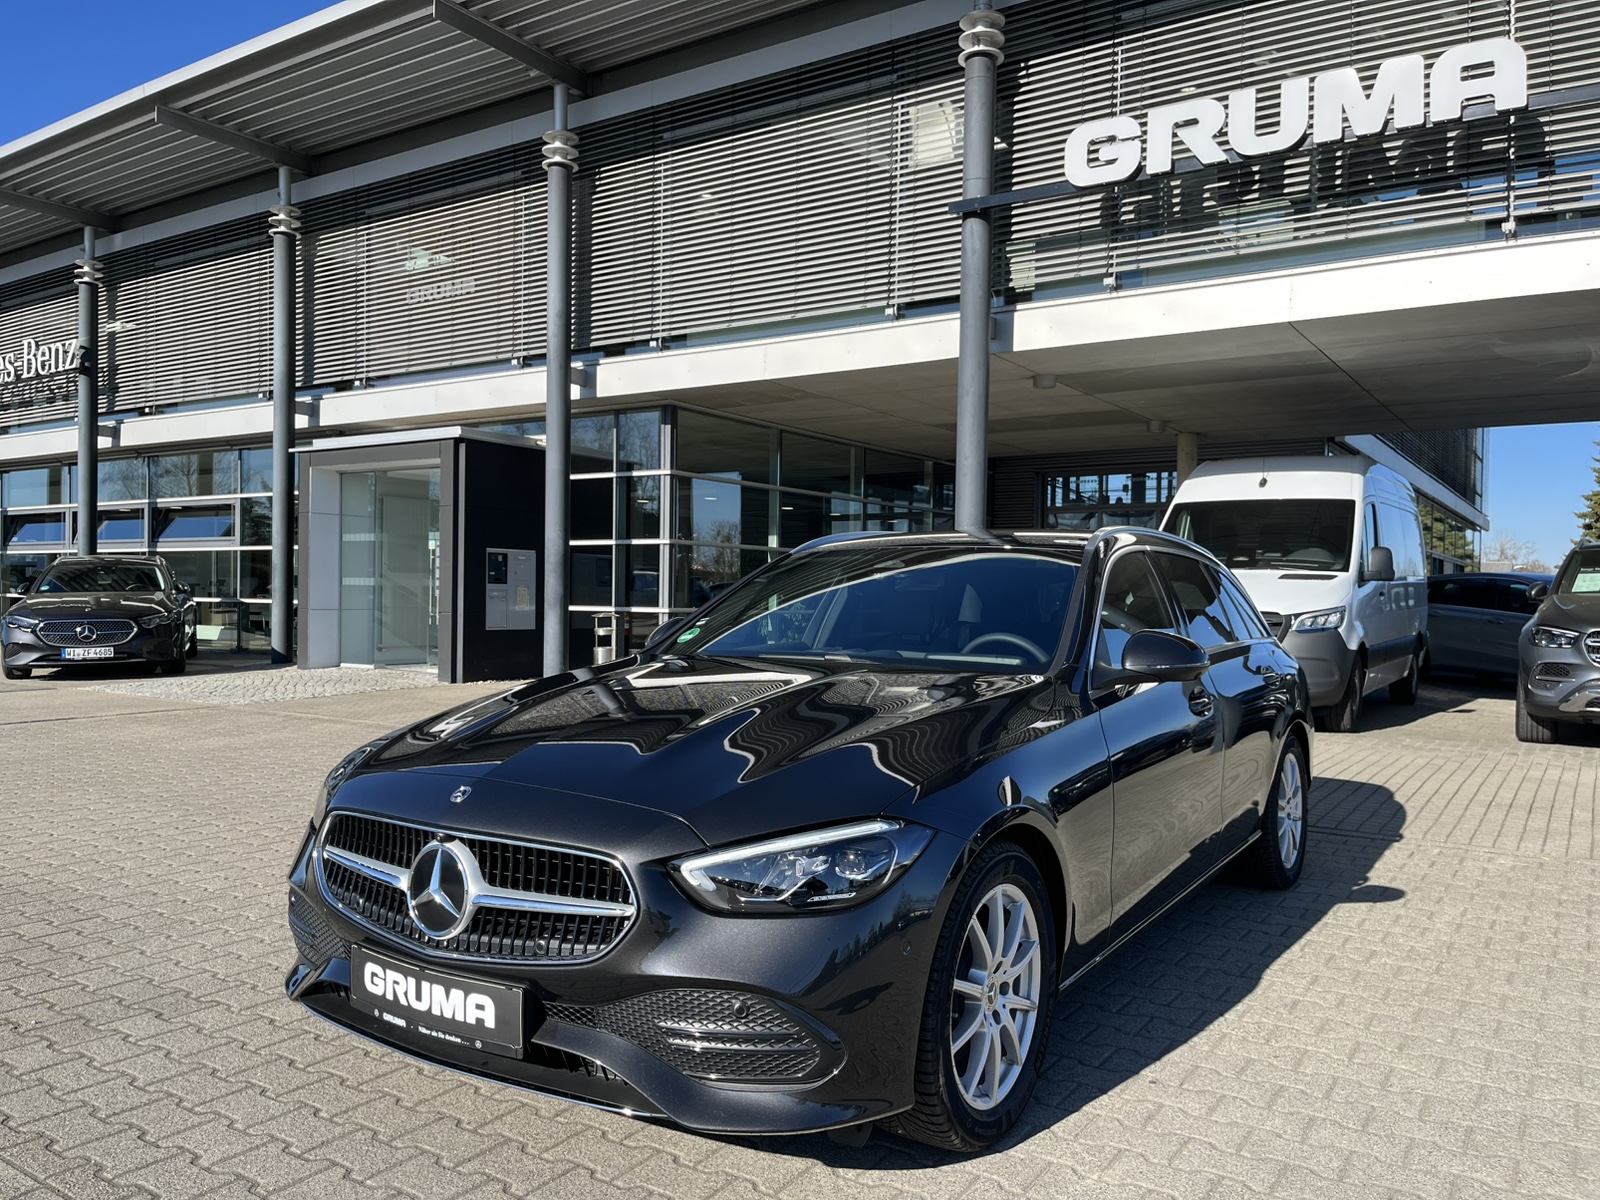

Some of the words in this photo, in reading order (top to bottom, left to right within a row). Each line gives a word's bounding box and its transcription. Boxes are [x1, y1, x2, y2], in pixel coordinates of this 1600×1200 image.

[1064, 38, 1527, 188] GRUMA
[66, 649, 76, 657] WI
[364, 961, 495, 1029] GRUMA
